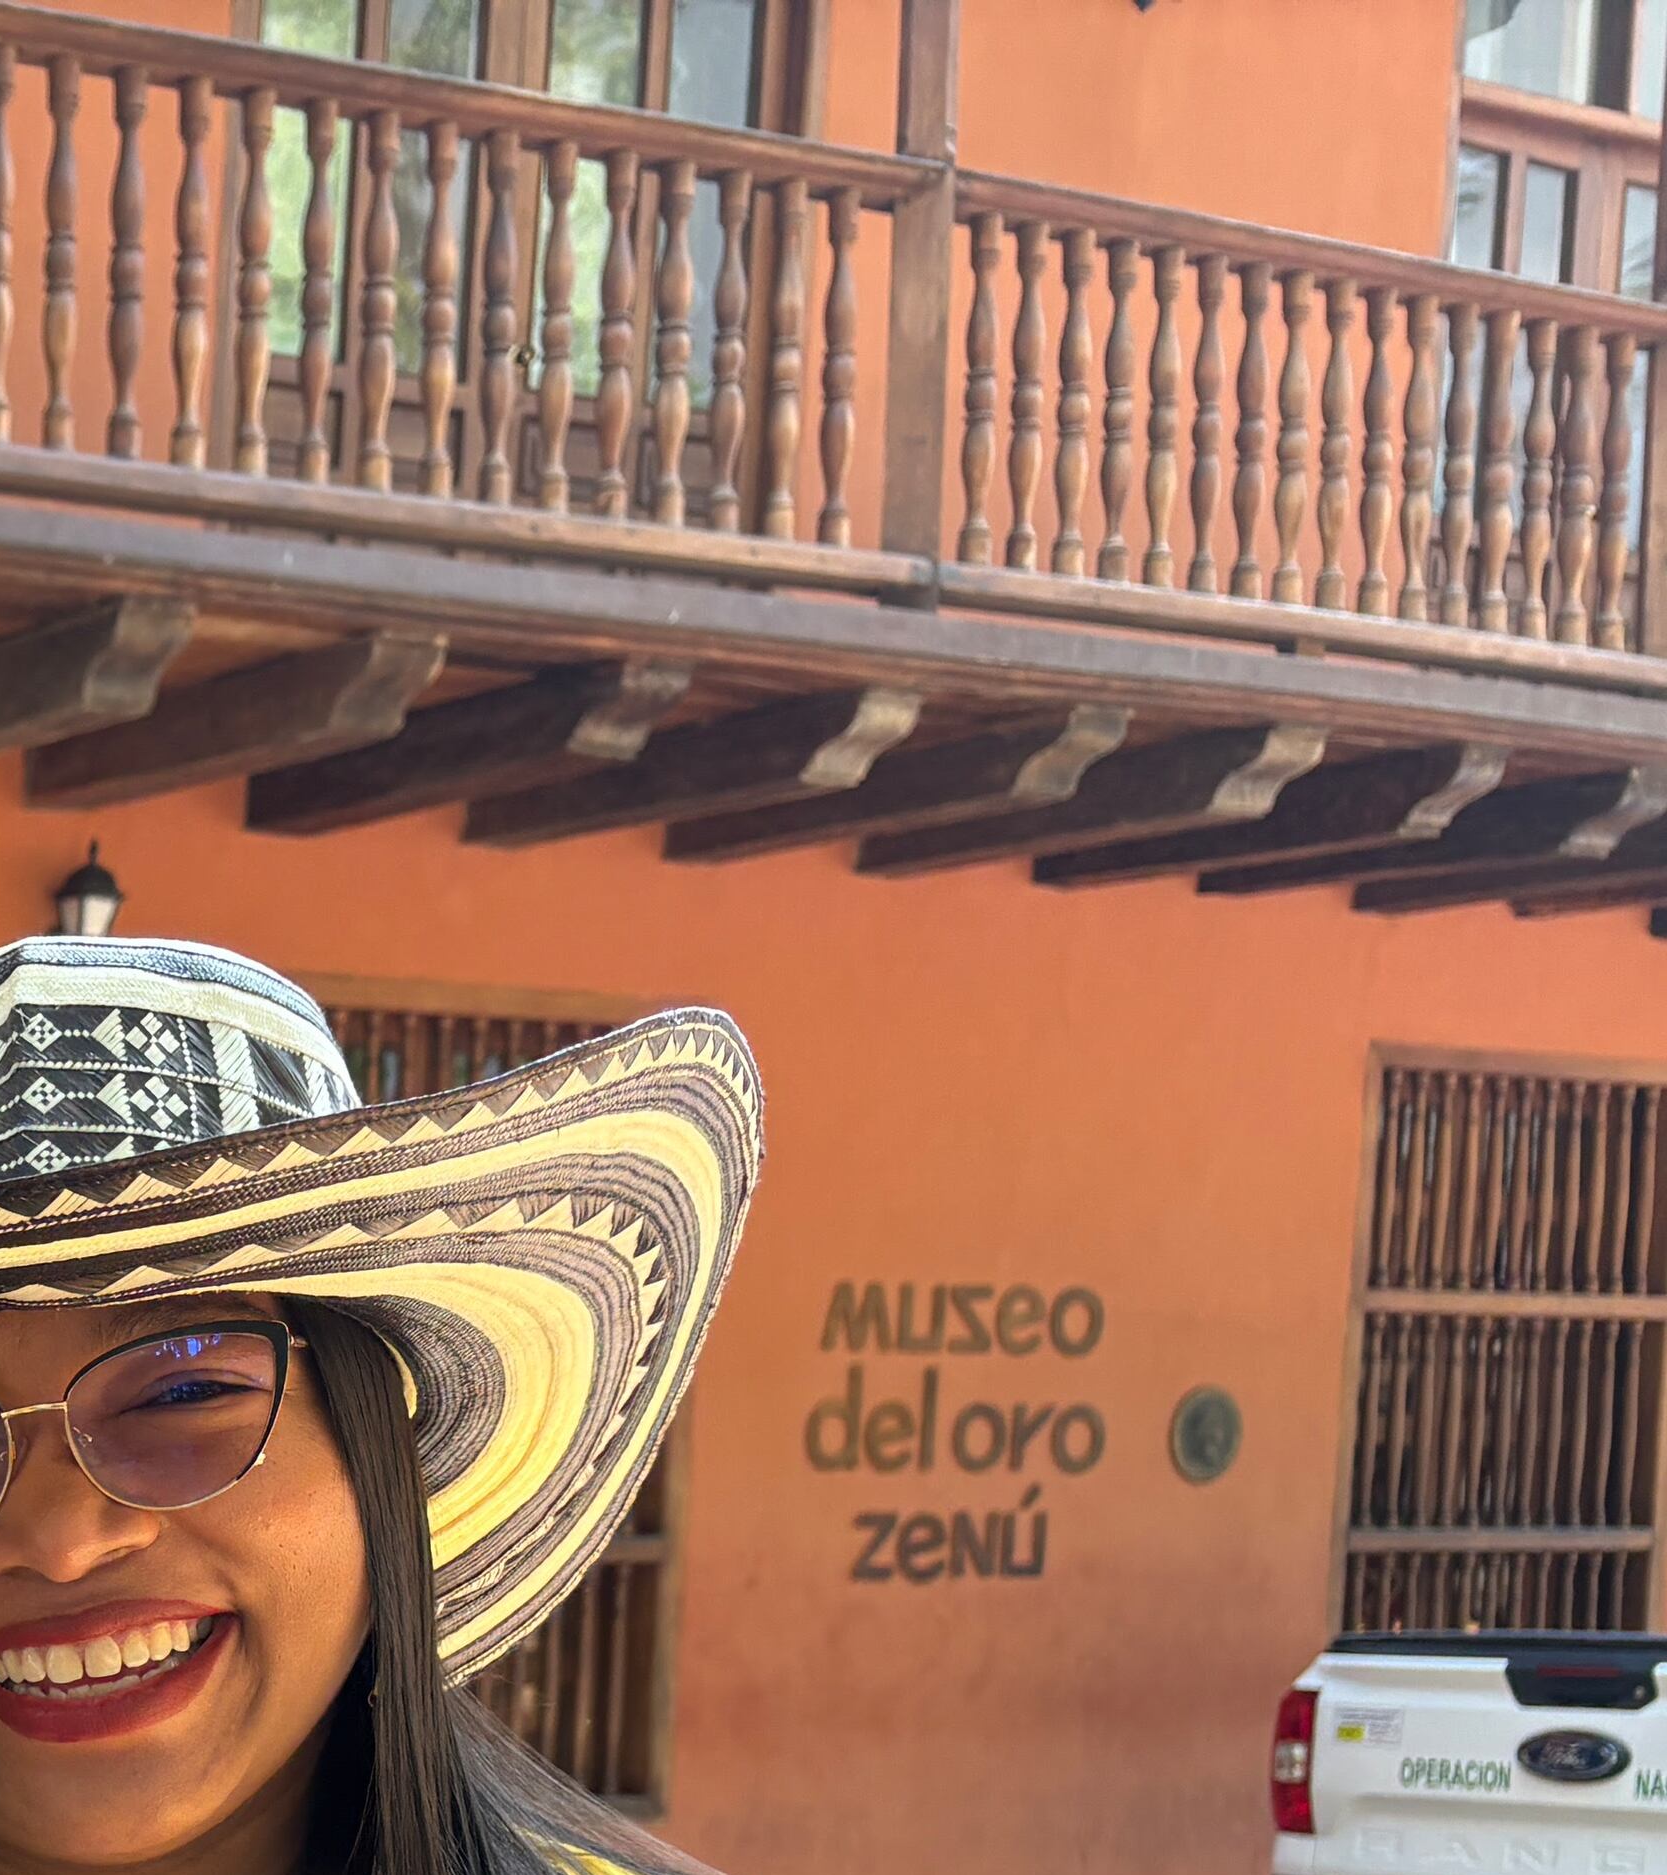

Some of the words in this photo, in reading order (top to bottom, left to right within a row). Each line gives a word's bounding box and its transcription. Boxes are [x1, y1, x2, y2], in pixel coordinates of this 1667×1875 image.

[803, 1361, 939, 1474] del
[952, 1403, 1105, 1474] oro
[1634, 1768, 1667, 1800] NA
